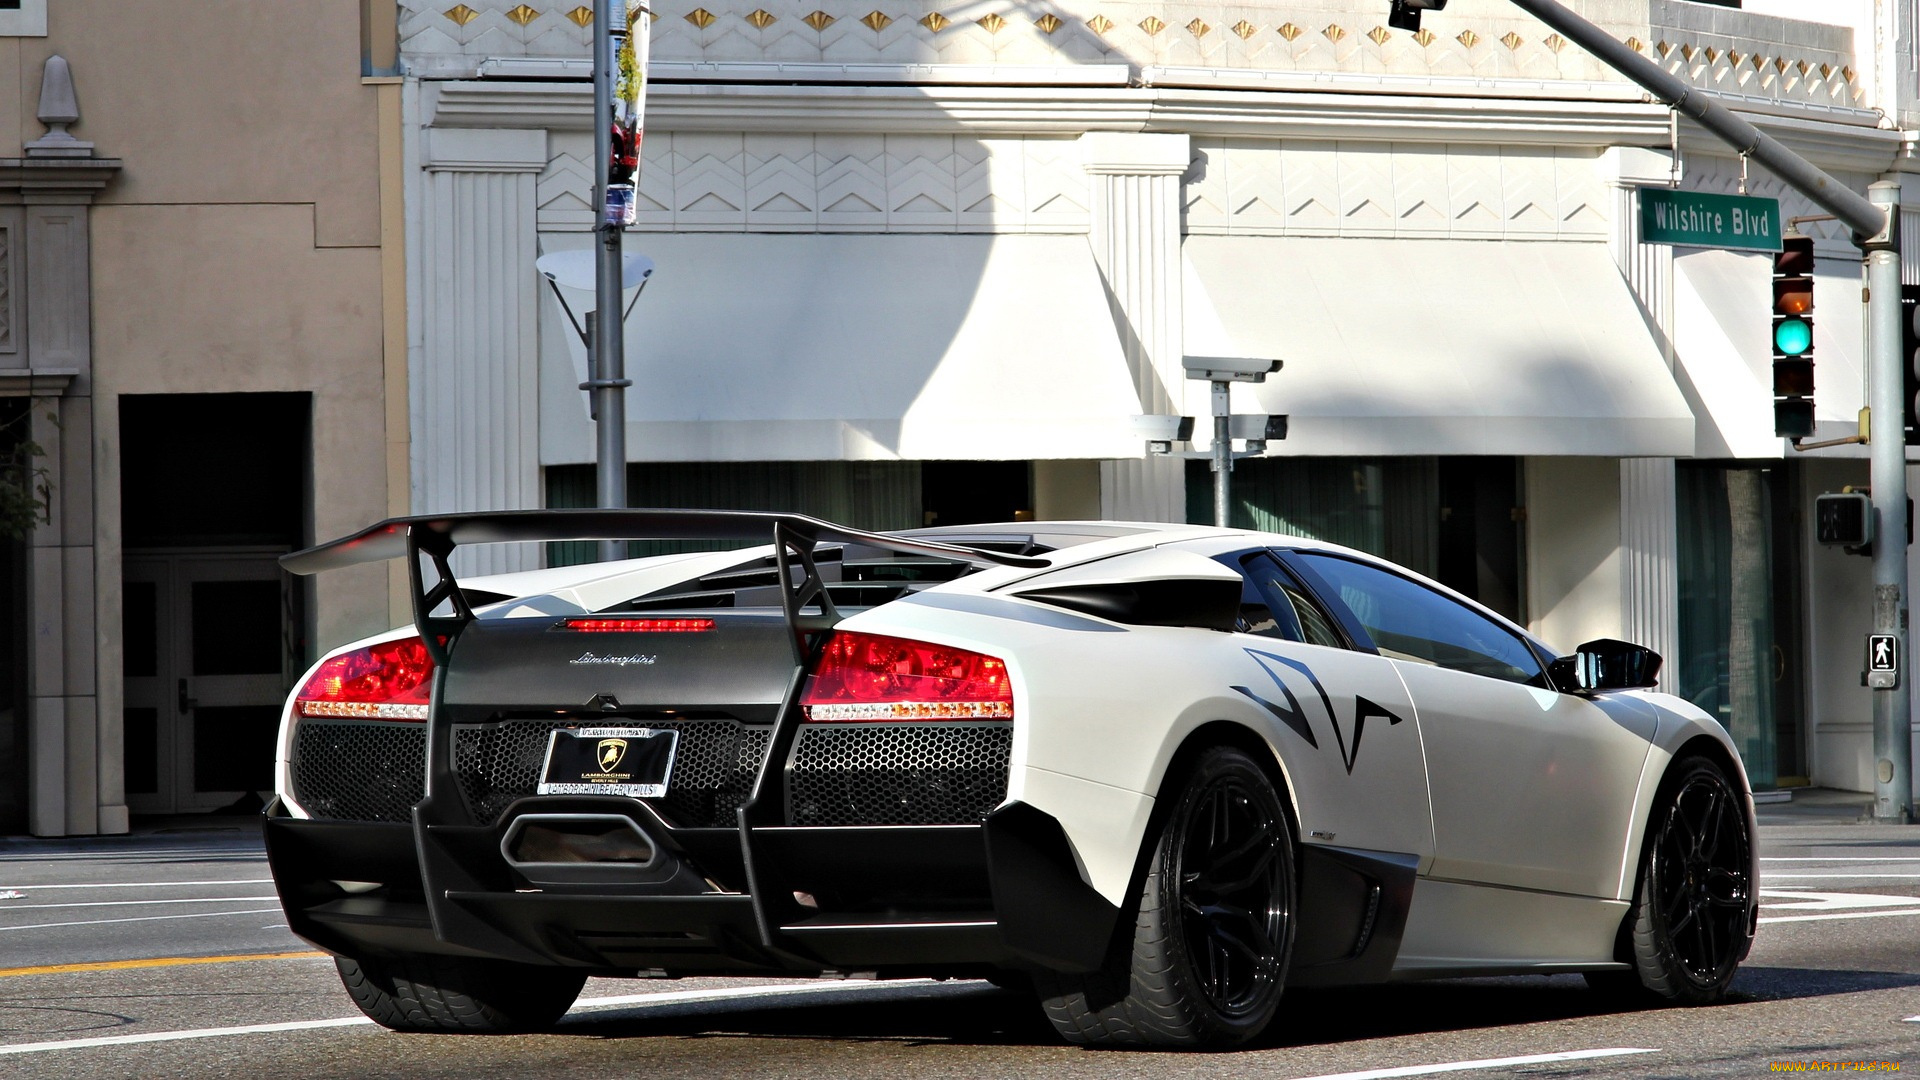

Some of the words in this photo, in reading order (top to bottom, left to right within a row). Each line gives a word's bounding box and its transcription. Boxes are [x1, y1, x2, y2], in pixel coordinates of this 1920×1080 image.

[1655, 202, 1722, 234] Wilshire
[1732, 207, 1769, 237] Blvd
[569, 651, 657, 666] Lamborghini
[633, 784, 654, 795] HILLS
